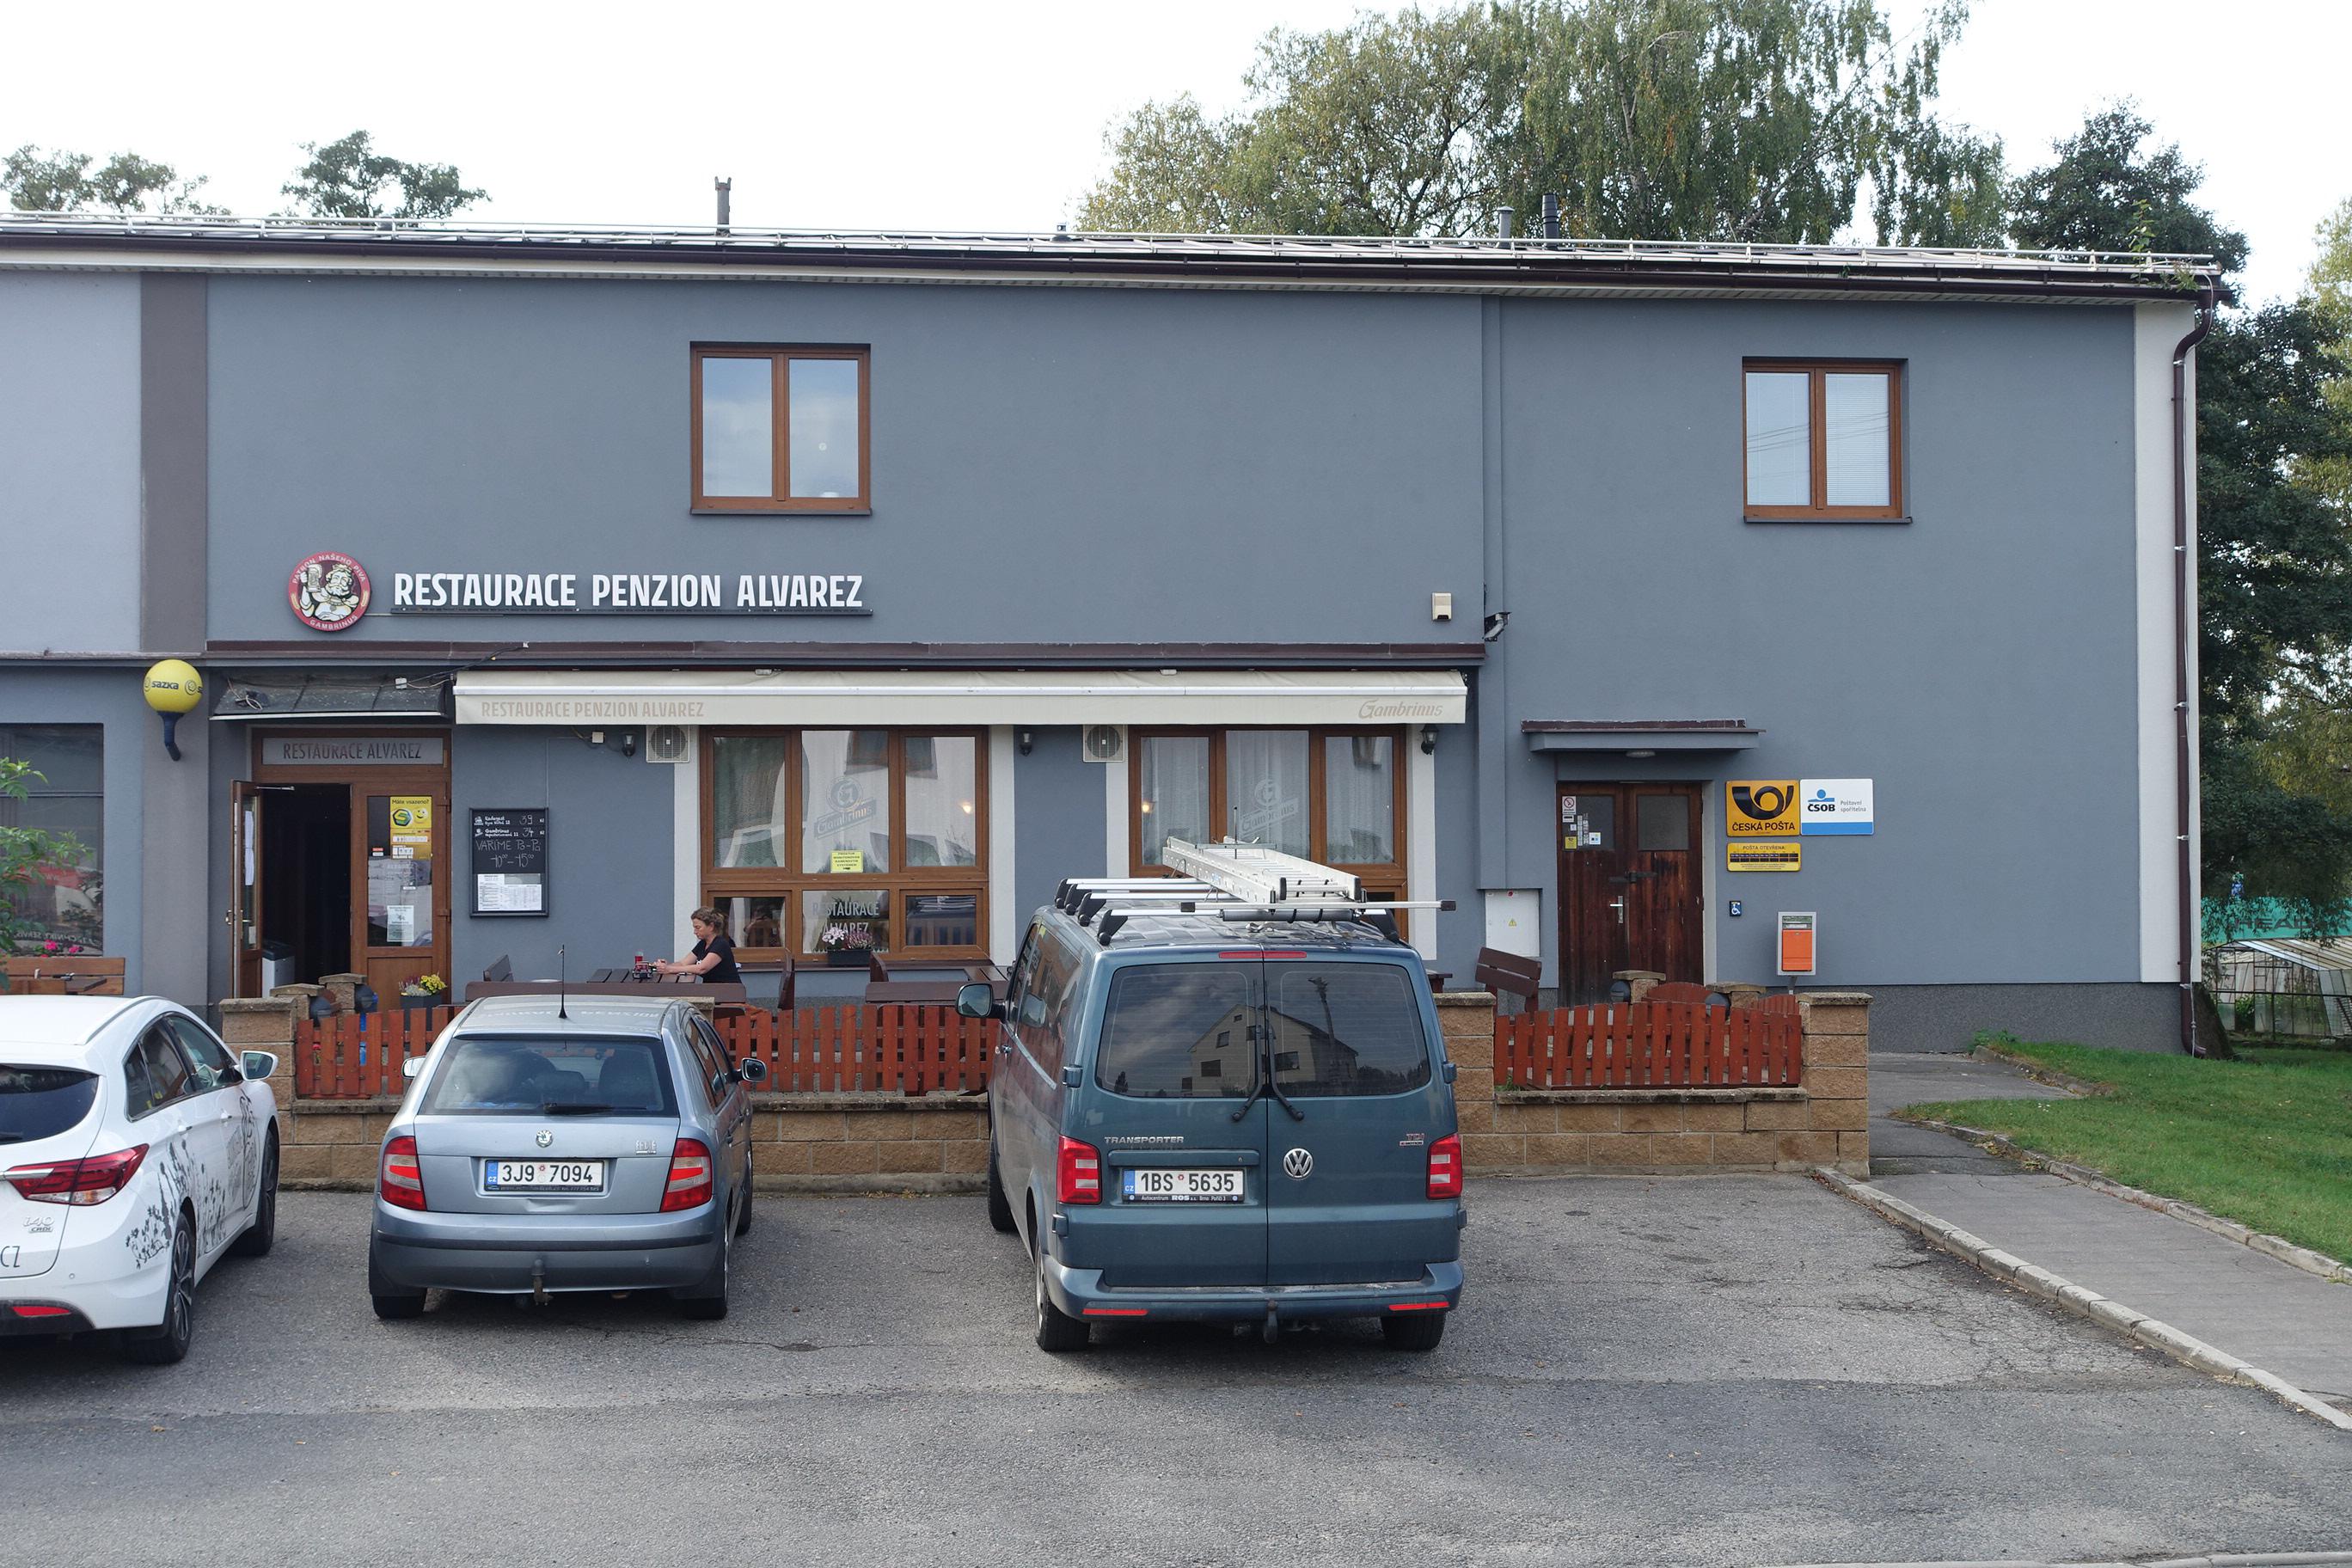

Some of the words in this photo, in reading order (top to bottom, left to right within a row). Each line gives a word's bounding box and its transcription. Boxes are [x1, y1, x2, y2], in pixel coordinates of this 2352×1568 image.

[292, 558, 316, 585] PATRON
[318, 554, 352, 565] NAŠEHO
[353, 565, 366, 583] PIVA
[395, 573, 576, 606] RESTAURACE
[592, 573, 721, 607] PENZION
[737, 574, 863, 607] ALVAREZ
[309, 616, 358, 630] GAMBRINUS
[481, 701, 571, 717] RESTAURACE
[574, 701, 638, 717] PENZION
[641, 701, 705, 717] ALVAREZ
[1358, 697, 1444, 719] Gambrinus
[284, 743, 363, 759] RESTAURACE
[366, 743, 422, 759] ALVAREZ
[1807, 803, 1835, 812] ČSOB
[519, 815, 533, 825] 39
[1732, 821, 1763, 831] ČESKÁ
[1765, 820, 1795, 830] POŠTA
[812, 901, 879, 916] RSTAURACE
[1104, 1136, 1185, 1144] TRANSPORTER
[502, 1165, 534, 1182] 3J9
[549, 1165, 593, 1183] 7094
[1141, 1173, 1173, 1191] 1BS
[1188, 1173, 1234, 1192] 5635
